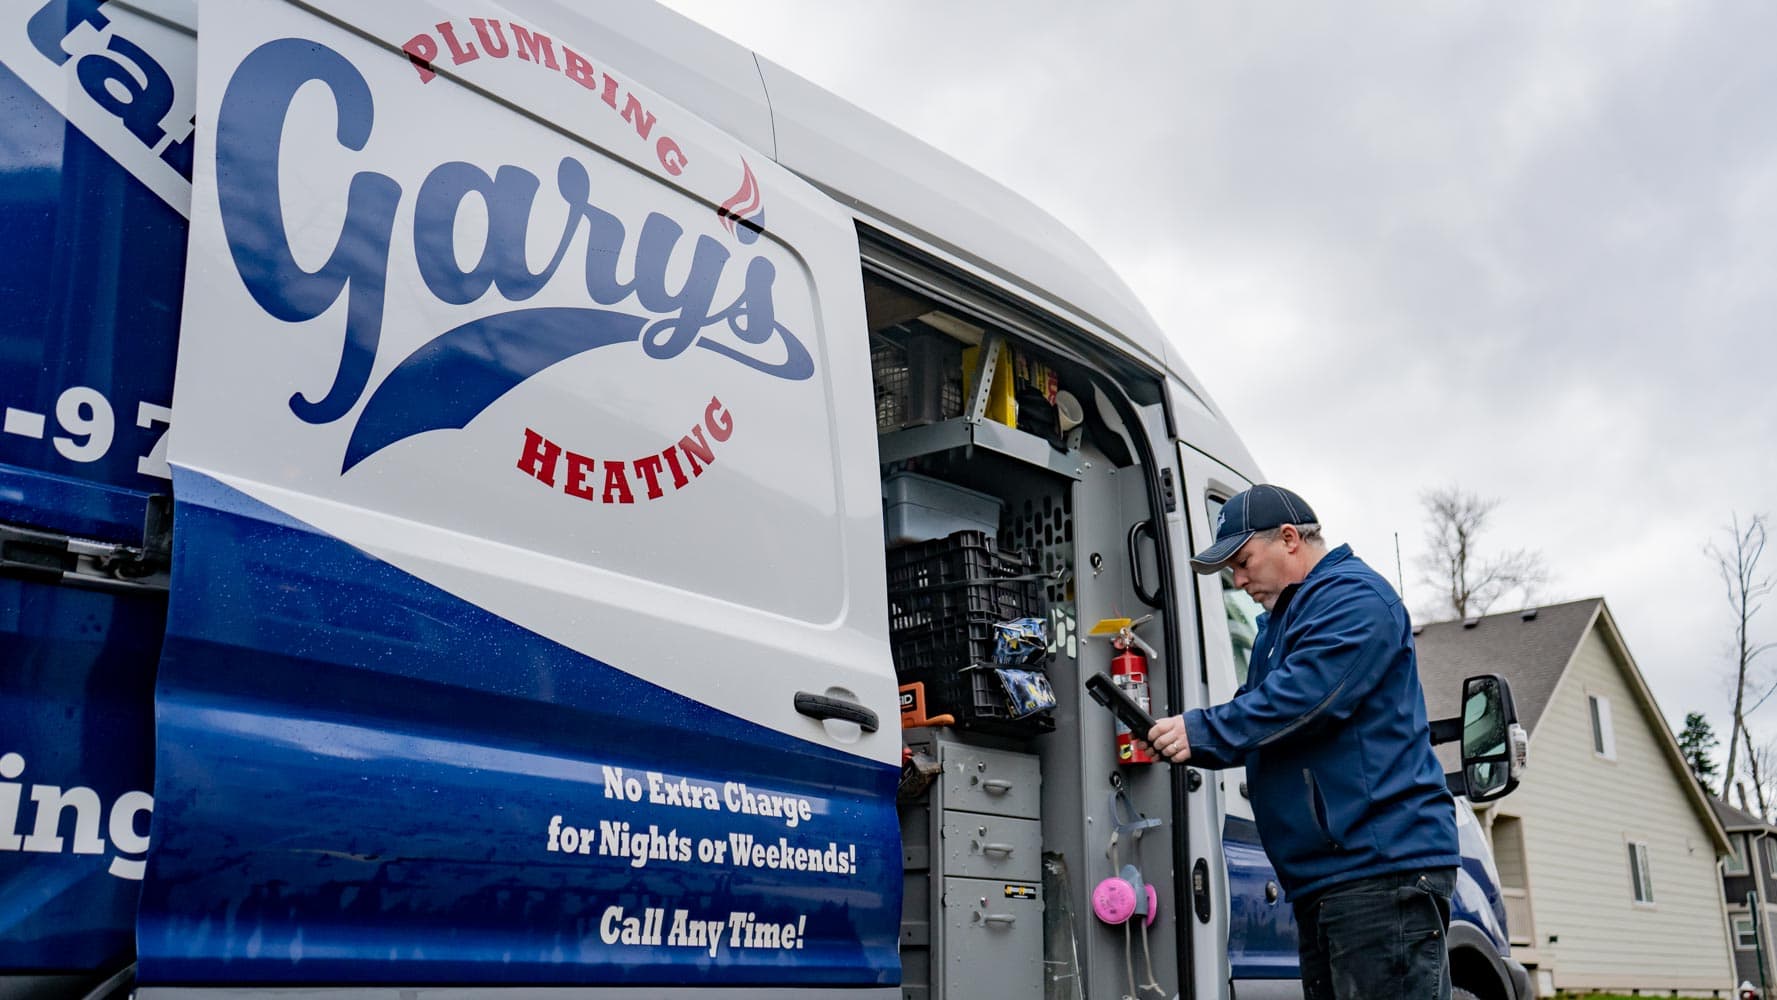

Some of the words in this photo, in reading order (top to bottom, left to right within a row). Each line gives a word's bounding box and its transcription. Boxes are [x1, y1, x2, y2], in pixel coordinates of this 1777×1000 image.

[27, 0, 196, 185] ta
[402, 17, 689, 176] PLUMBING
[517, 396, 733, 504] HEATING
[602, 765, 642, 802] No
[647, 771, 720, 811] Extra
[724, 781, 812, 828] Charge
[547, 816, 595, 854] for
[599, 820, 691, 868] Nights
[698, 838, 727, 864] or
[729, 833, 857, 874] Weekends!
[600, 905, 664, 945] Call
[667, 909, 724, 957] Any
[729, 912, 806, 949] Time!
